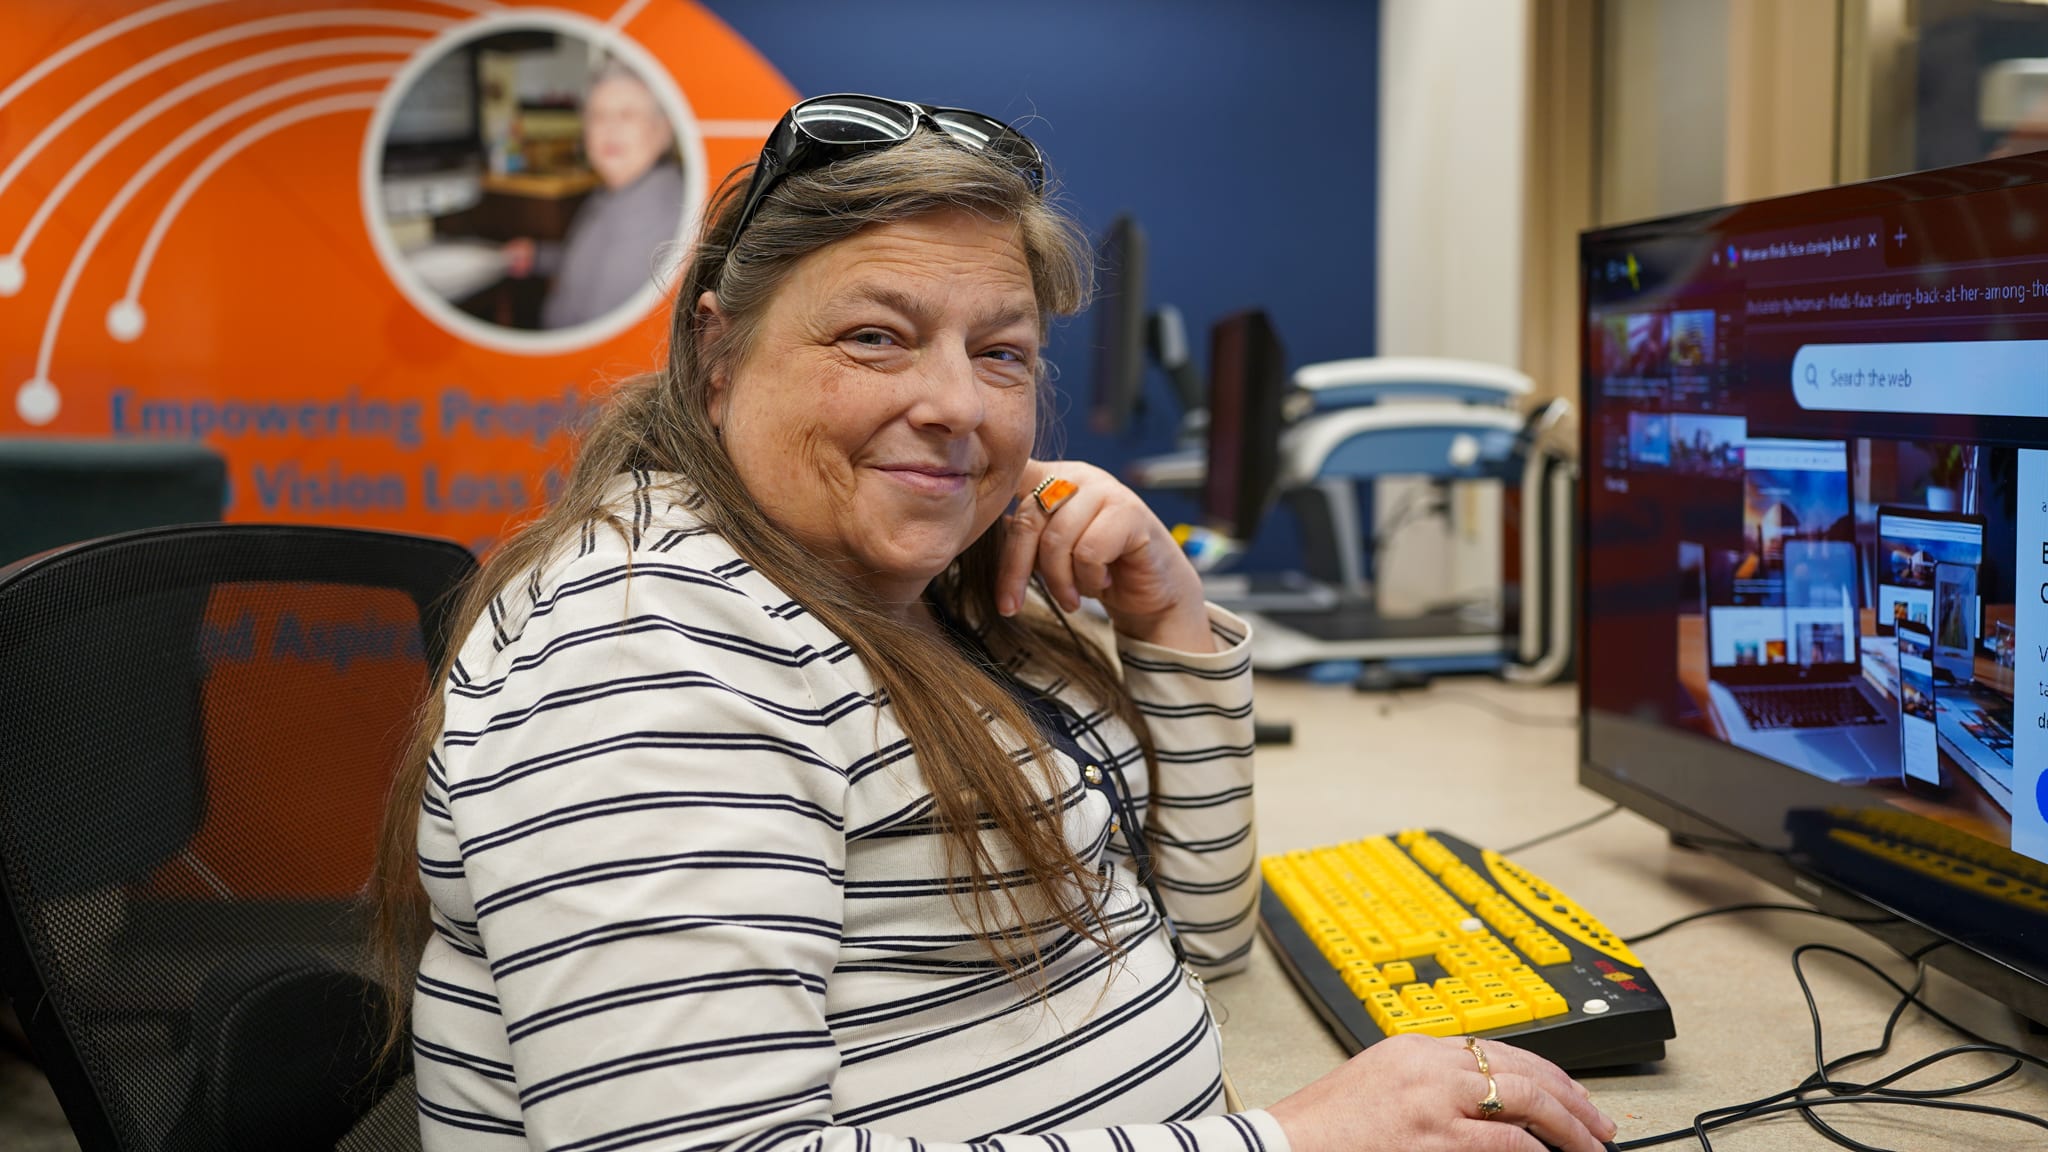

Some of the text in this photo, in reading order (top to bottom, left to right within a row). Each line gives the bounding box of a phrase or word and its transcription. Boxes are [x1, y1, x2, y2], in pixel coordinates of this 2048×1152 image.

[1830, 367, 1912, 388] Search the web
[111, 389, 422, 448] Empowering
[253, 464, 405, 510] Vision
[424, 464, 528, 511] Loss
